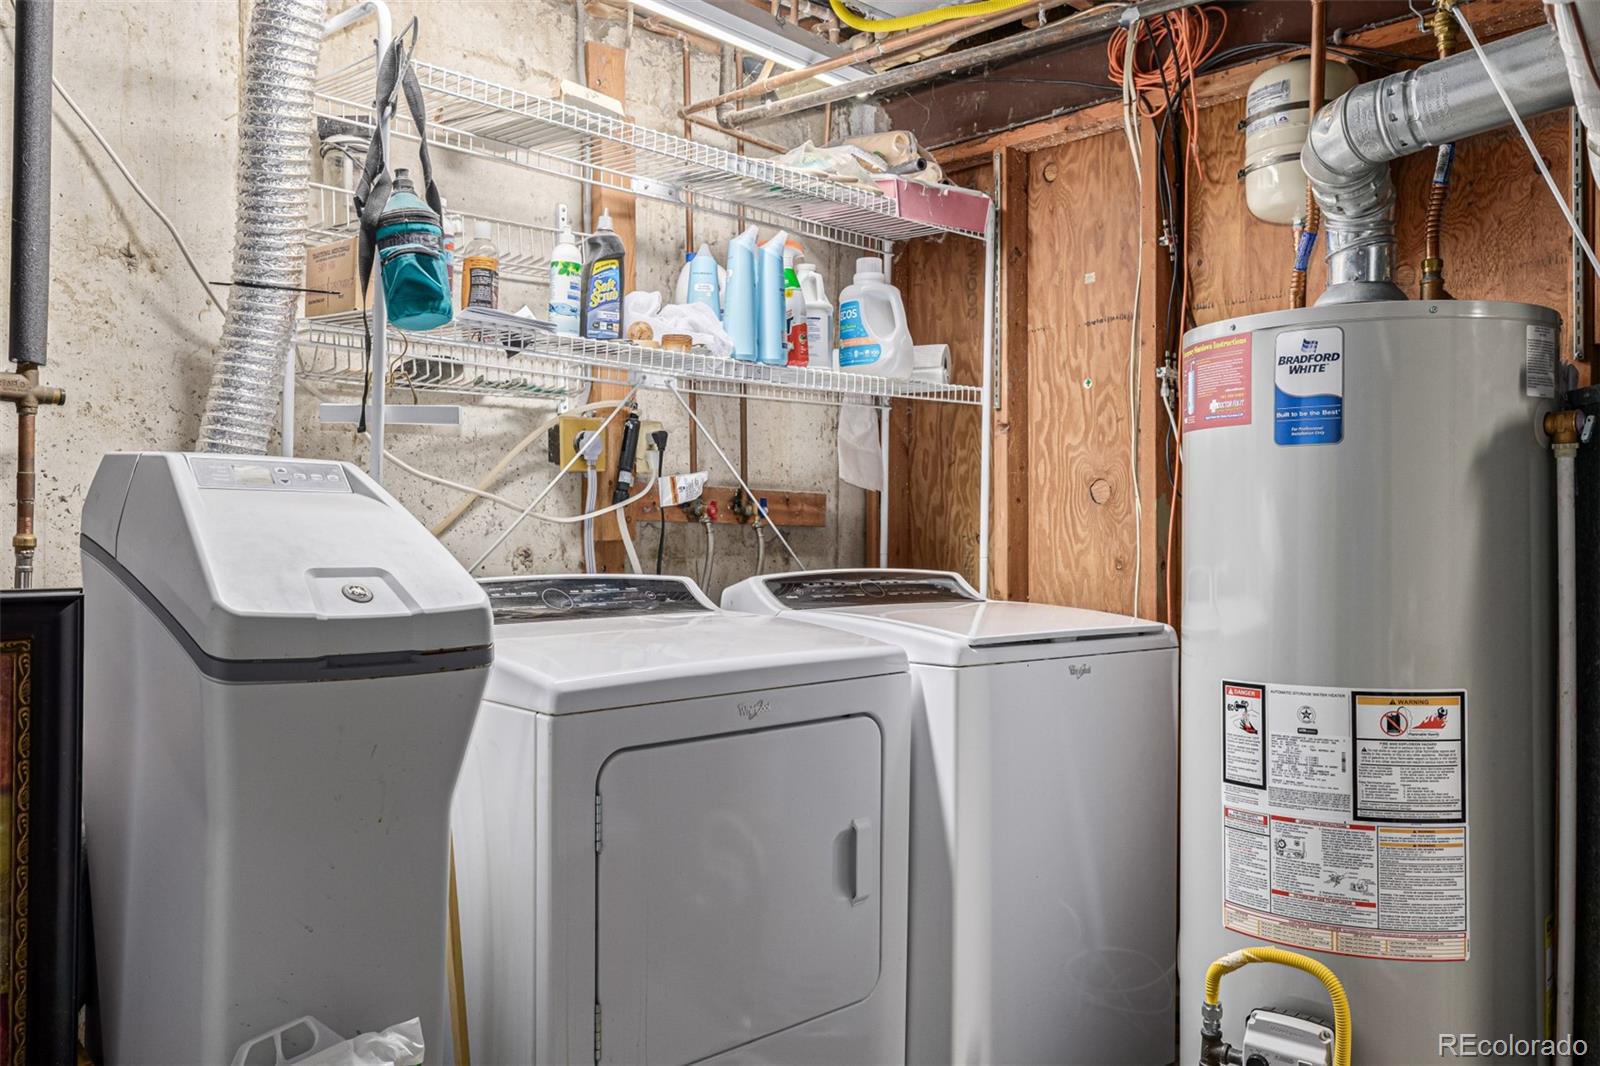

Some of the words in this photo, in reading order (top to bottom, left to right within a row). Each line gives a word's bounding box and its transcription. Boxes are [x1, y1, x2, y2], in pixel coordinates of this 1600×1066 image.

[594, 278, 616, 293] Soft
[590, 288, 619, 307] Scrub
[1278, 352, 1341, 366] BRADFORD
[1288, 363, 1326, 375] WHITE
[1233, 688, 1256, 697] DANGER
